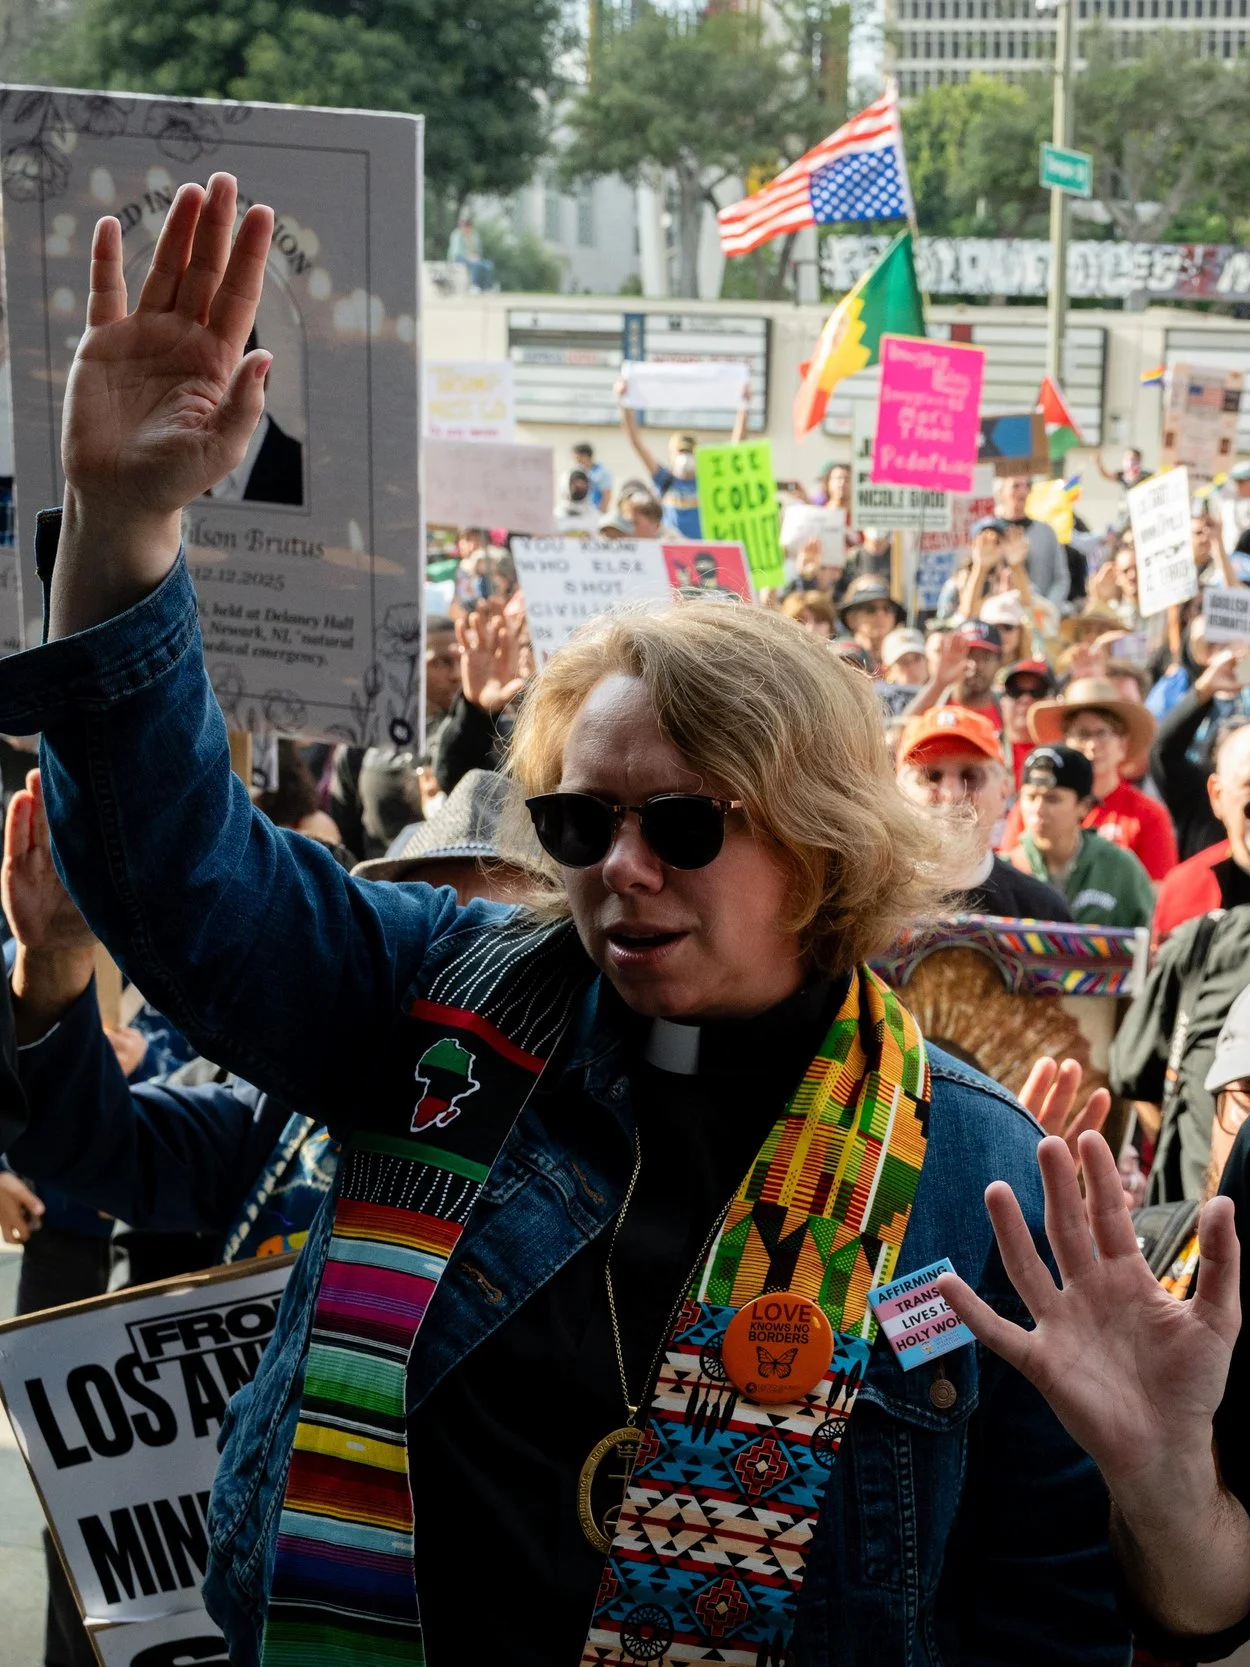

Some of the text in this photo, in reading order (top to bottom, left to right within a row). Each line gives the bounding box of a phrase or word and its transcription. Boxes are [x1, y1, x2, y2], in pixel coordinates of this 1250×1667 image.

[711, 481, 769, 513] COLD
[183, 520, 325, 559] ilson Brutus
[517, 537, 638, 554] YOU KNOW
[518, 558, 571, 573] WHO
[563, 580, 624, 595] SHOT
[213, 602, 244, 619] held
[246, 607, 261, 621] at
[322, 614, 354, 630] Hall
[878, 1265, 949, 1304] AFFIRMING
[895, 1286, 940, 1313] TRANS
[751, 1302, 812, 1323] LOVE
[901, 1306, 938, 1329] LIVES
[138, 1303, 282, 1358] FRO
[747, 1331, 810, 1345] BORDERS
[749, 1321, 810, 1333] KNOWS NO
[895, 1328, 930, 1352] HOLY
[24, 1353, 179, 1470] LOS
[78, 1490, 210, 1605] MIN
